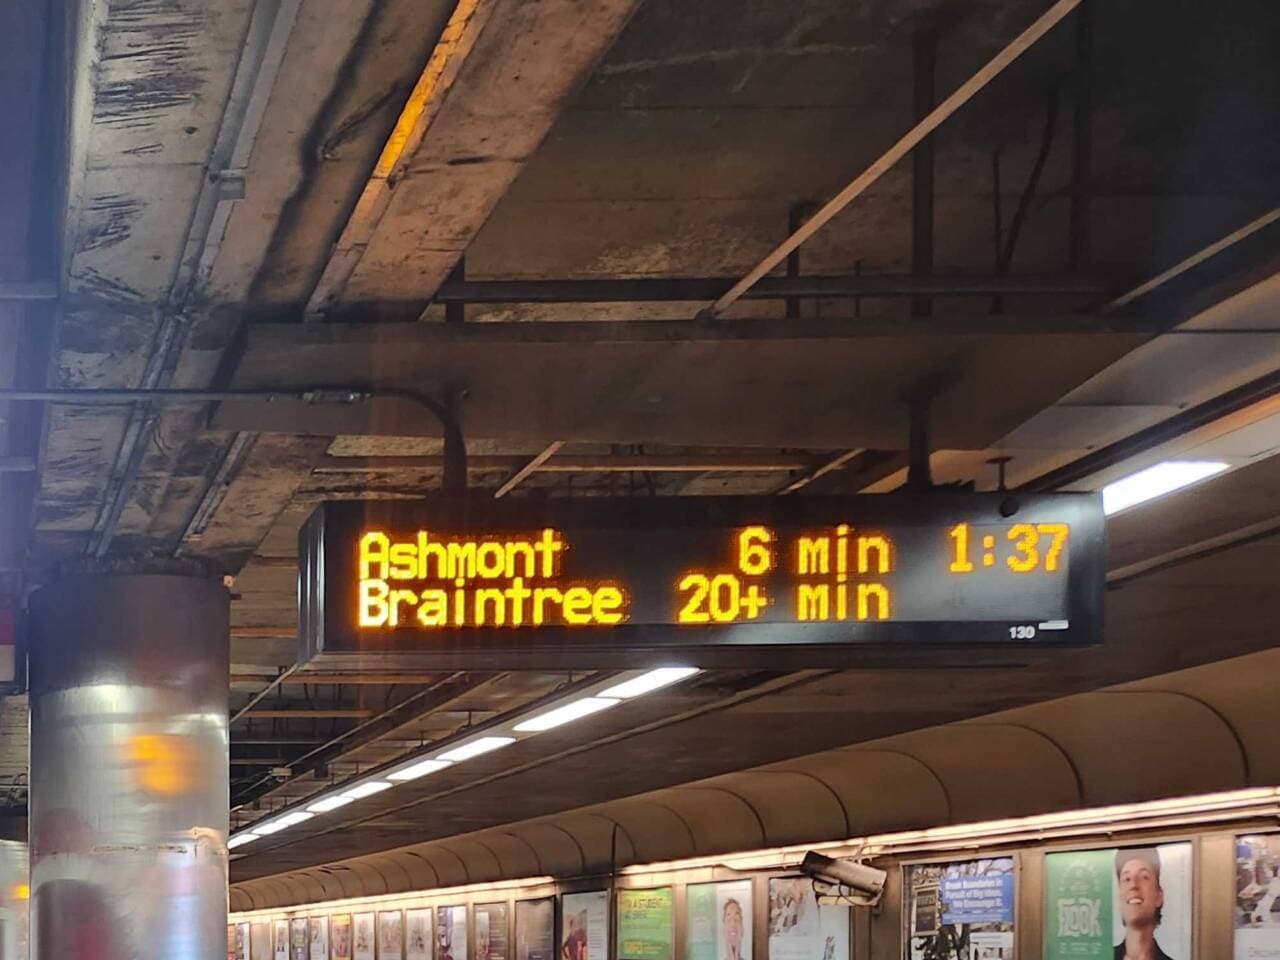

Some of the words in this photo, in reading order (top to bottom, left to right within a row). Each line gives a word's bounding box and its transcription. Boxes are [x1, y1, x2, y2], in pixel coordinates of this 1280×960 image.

[359, 529, 562, 579] Ashmont
[739, 526, 771, 576] 6
[797, 524, 889, 575] min
[949, 523, 1069, 573] 1:37
[358, 577, 624, 627] Braintree
[678, 574, 768, 623] 20+
[797, 573, 889, 621] min
[1009, 625, 1035, 639] 130
